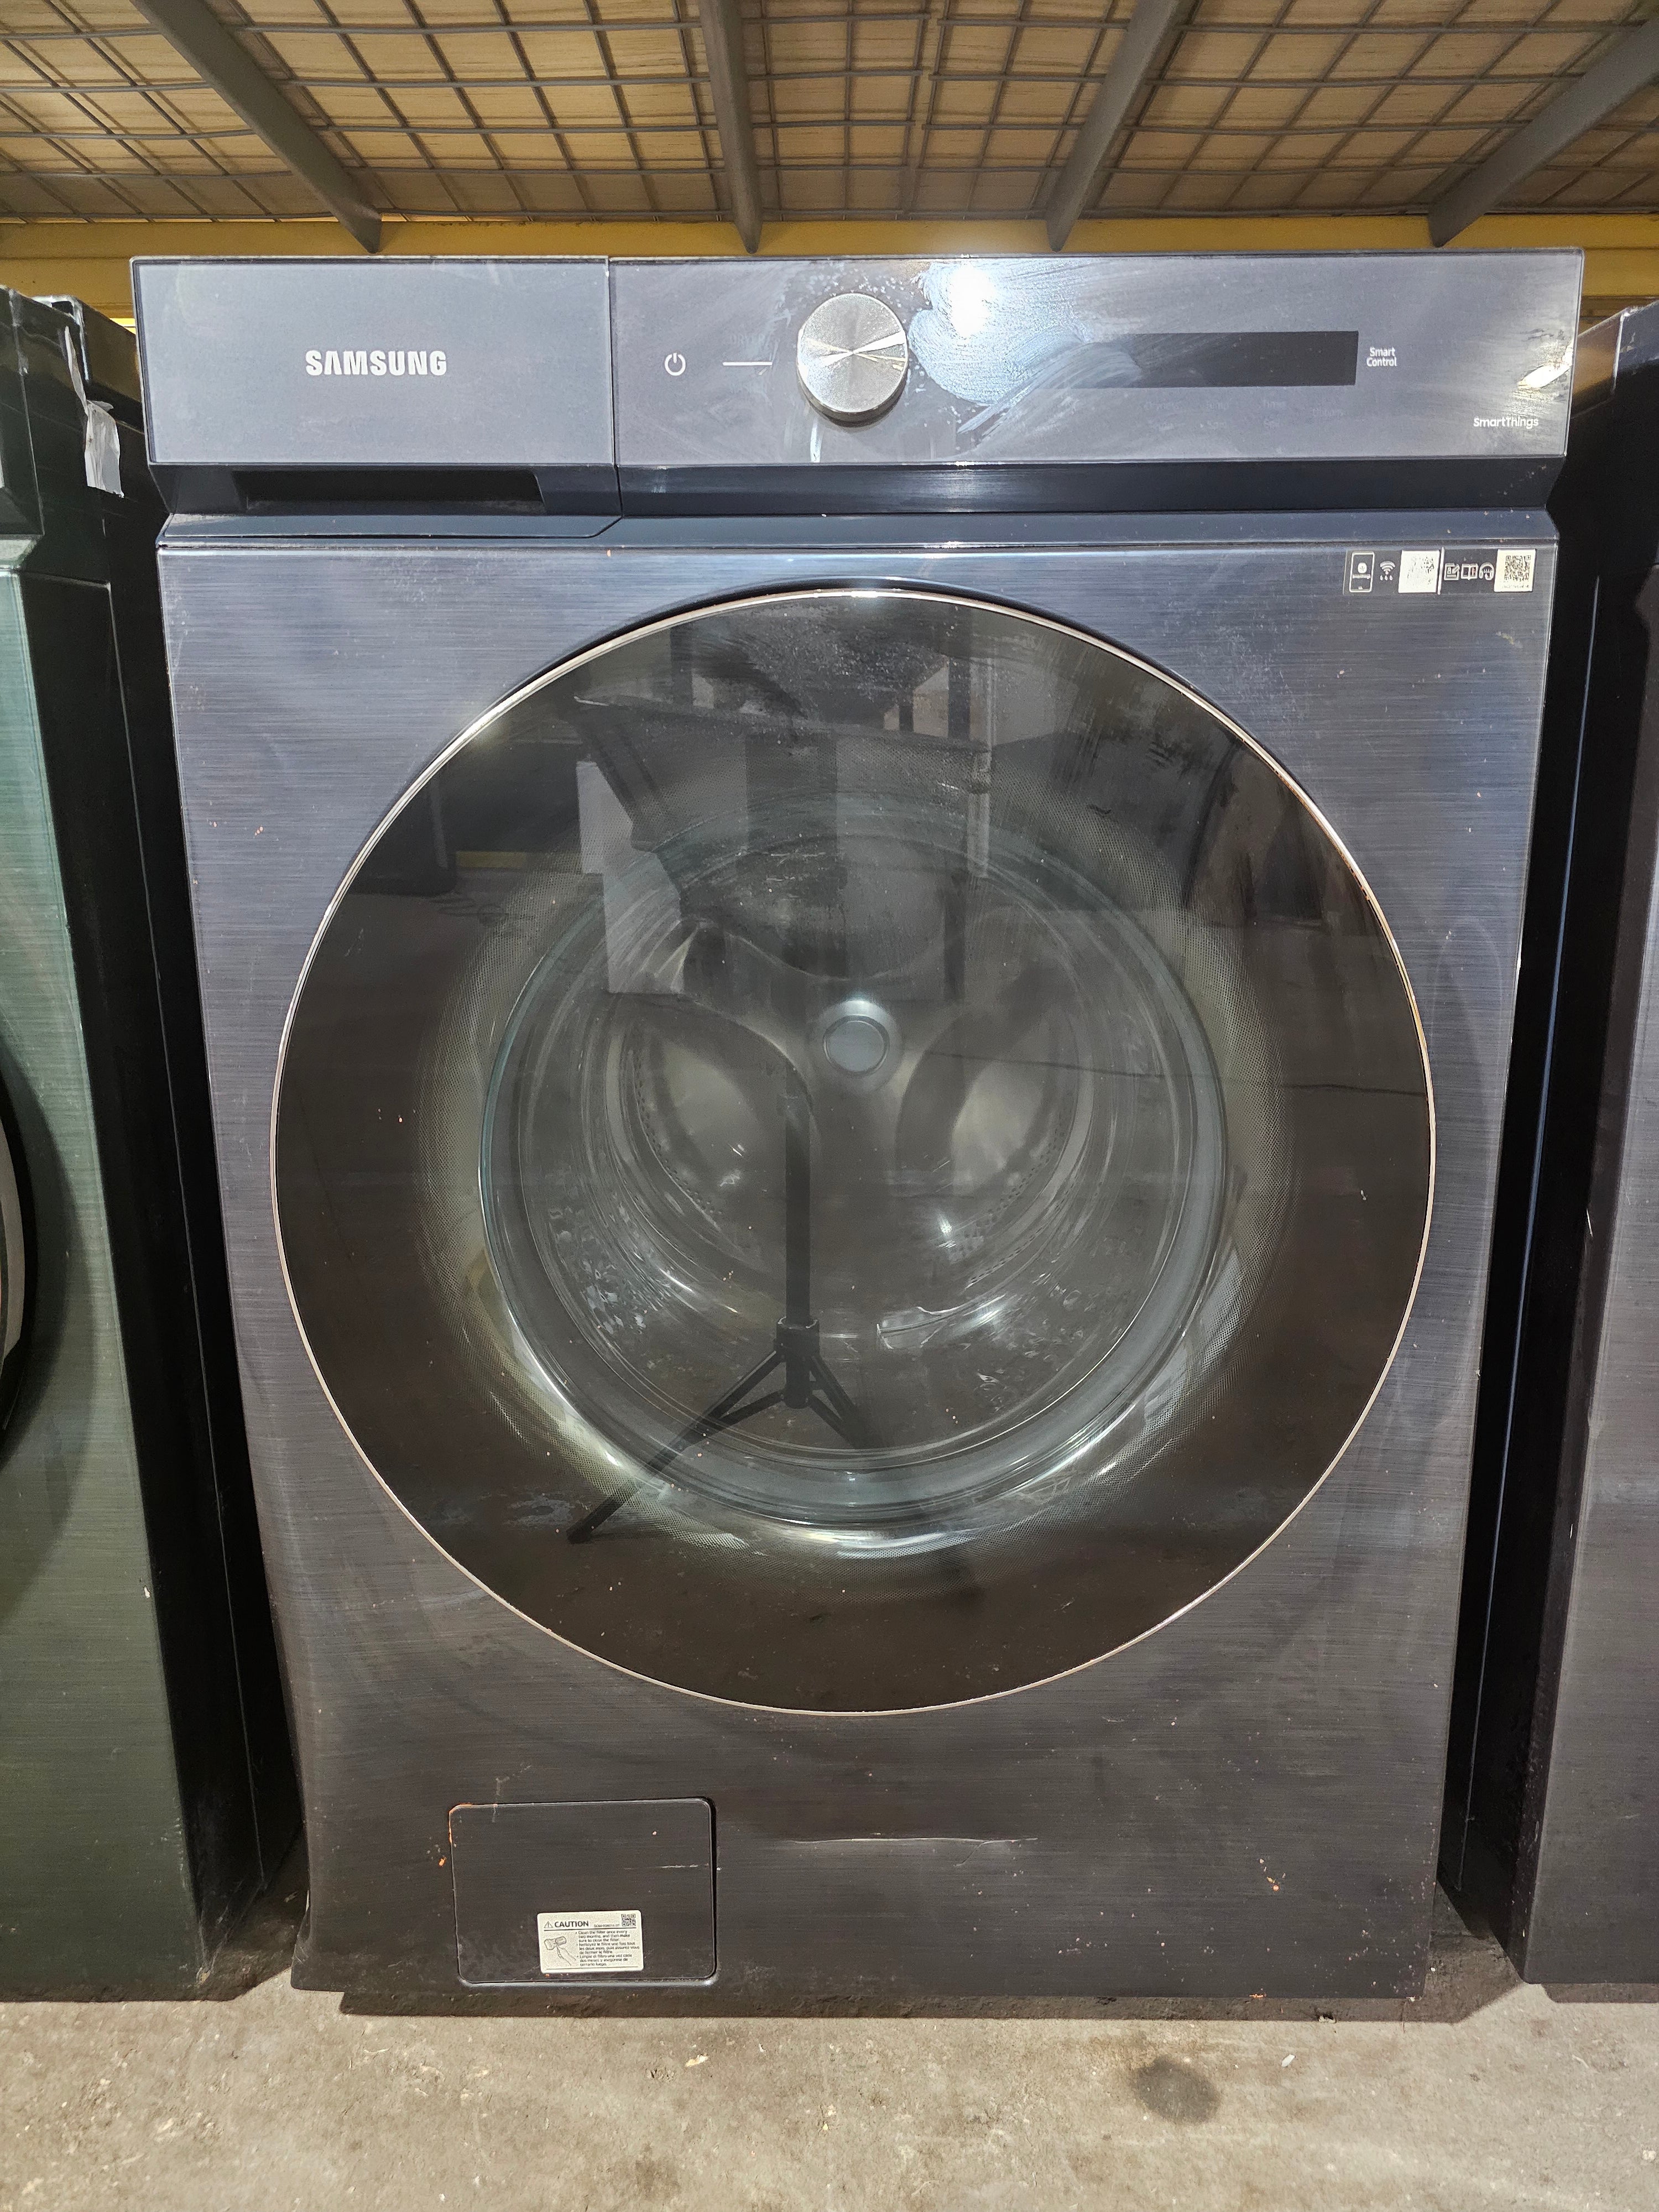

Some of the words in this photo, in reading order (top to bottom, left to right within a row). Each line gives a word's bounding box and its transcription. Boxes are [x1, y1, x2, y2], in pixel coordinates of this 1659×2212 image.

[1369, 346, 1396, 357] Smart
[305, 350, 447, 376] SAMSUNG
[1366, 357, 1397, 367] Control
[1473, 416, 1539, 430] SmartThings
